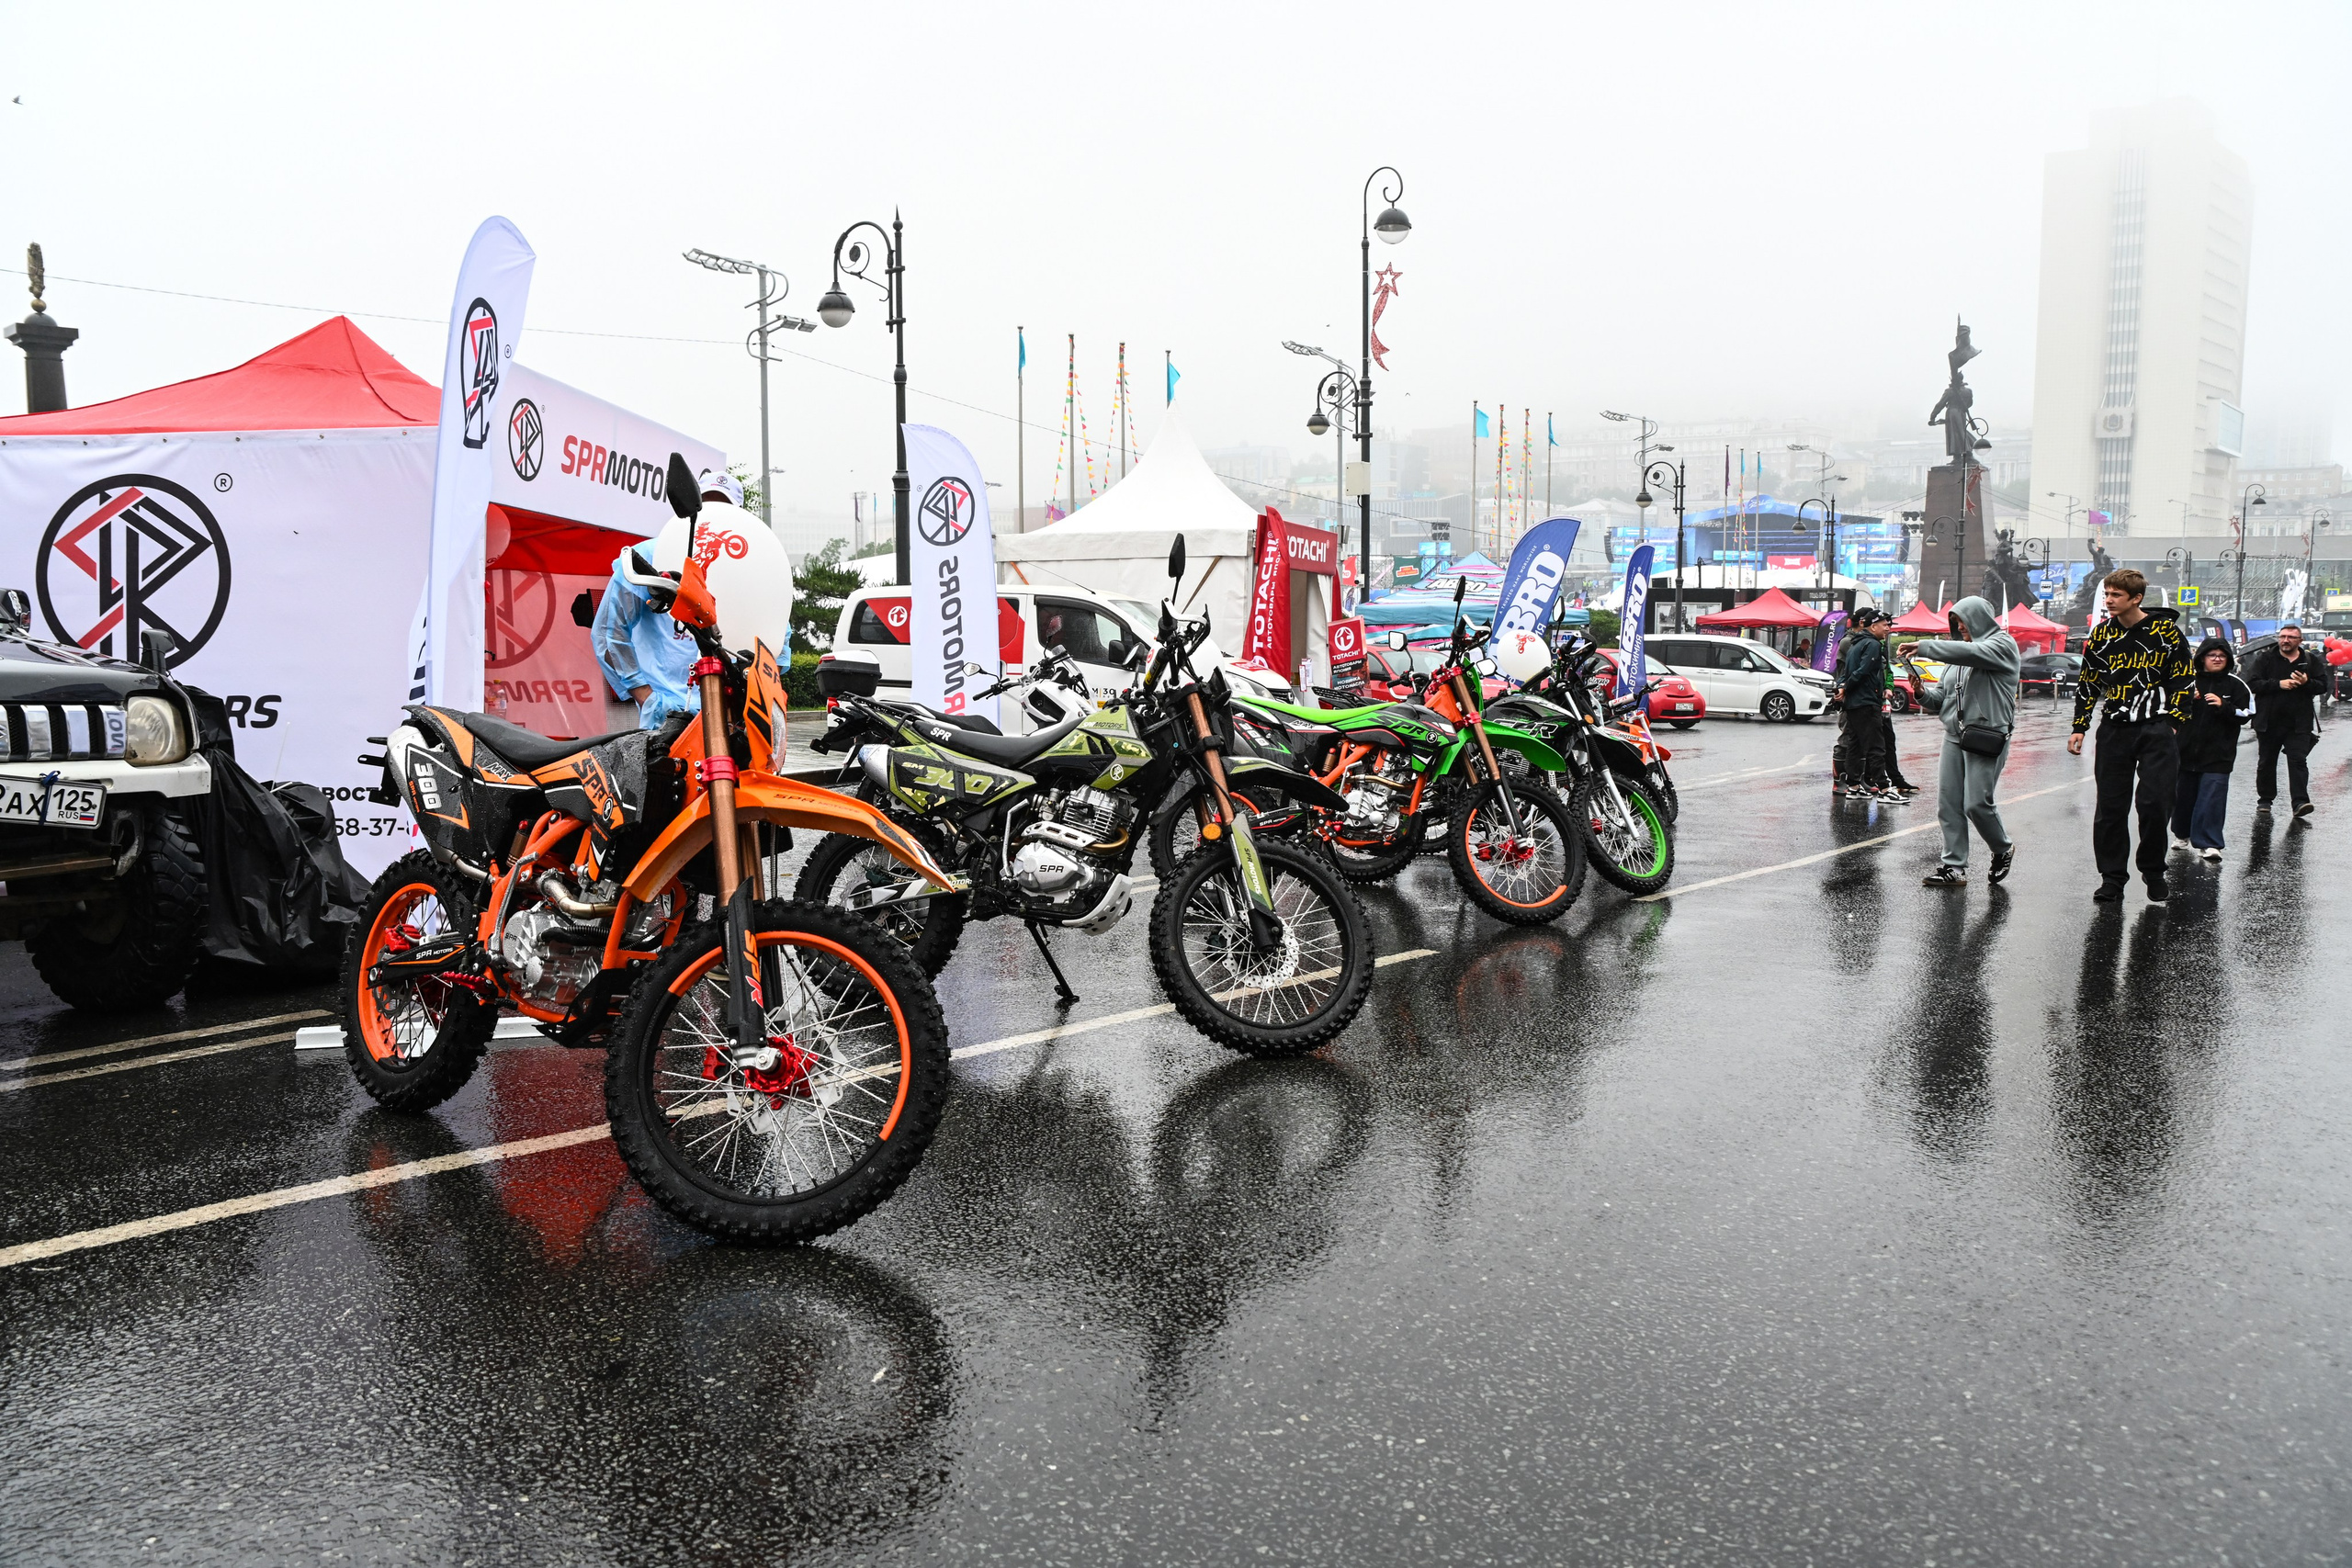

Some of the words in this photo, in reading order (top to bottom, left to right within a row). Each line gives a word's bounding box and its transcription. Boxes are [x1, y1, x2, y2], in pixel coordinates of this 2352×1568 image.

[1287, 536, 1327, 563] OTACHI
[1619, 571, 1648, 686] ABRO
[1824, 618, 1837, 671] NGT-AUTO.RU
[1332, 650, 1359, 660] TOTACHI
[930, 727, 952, 742] SPR
[484, 762, 514, 783] MAX
[413, 762, 443, 810] 300
[53, 789, 94, 812] 125
[774, 793, 815, 804] SPR
[58, 810, 79, 819] RUS
[334, 818, 410, 836] 58-37-
[1039, 864, 1065, 873] SPR
[415, 949, 433, 960] SPR
[433, 947, 454, 956] MOTORS
